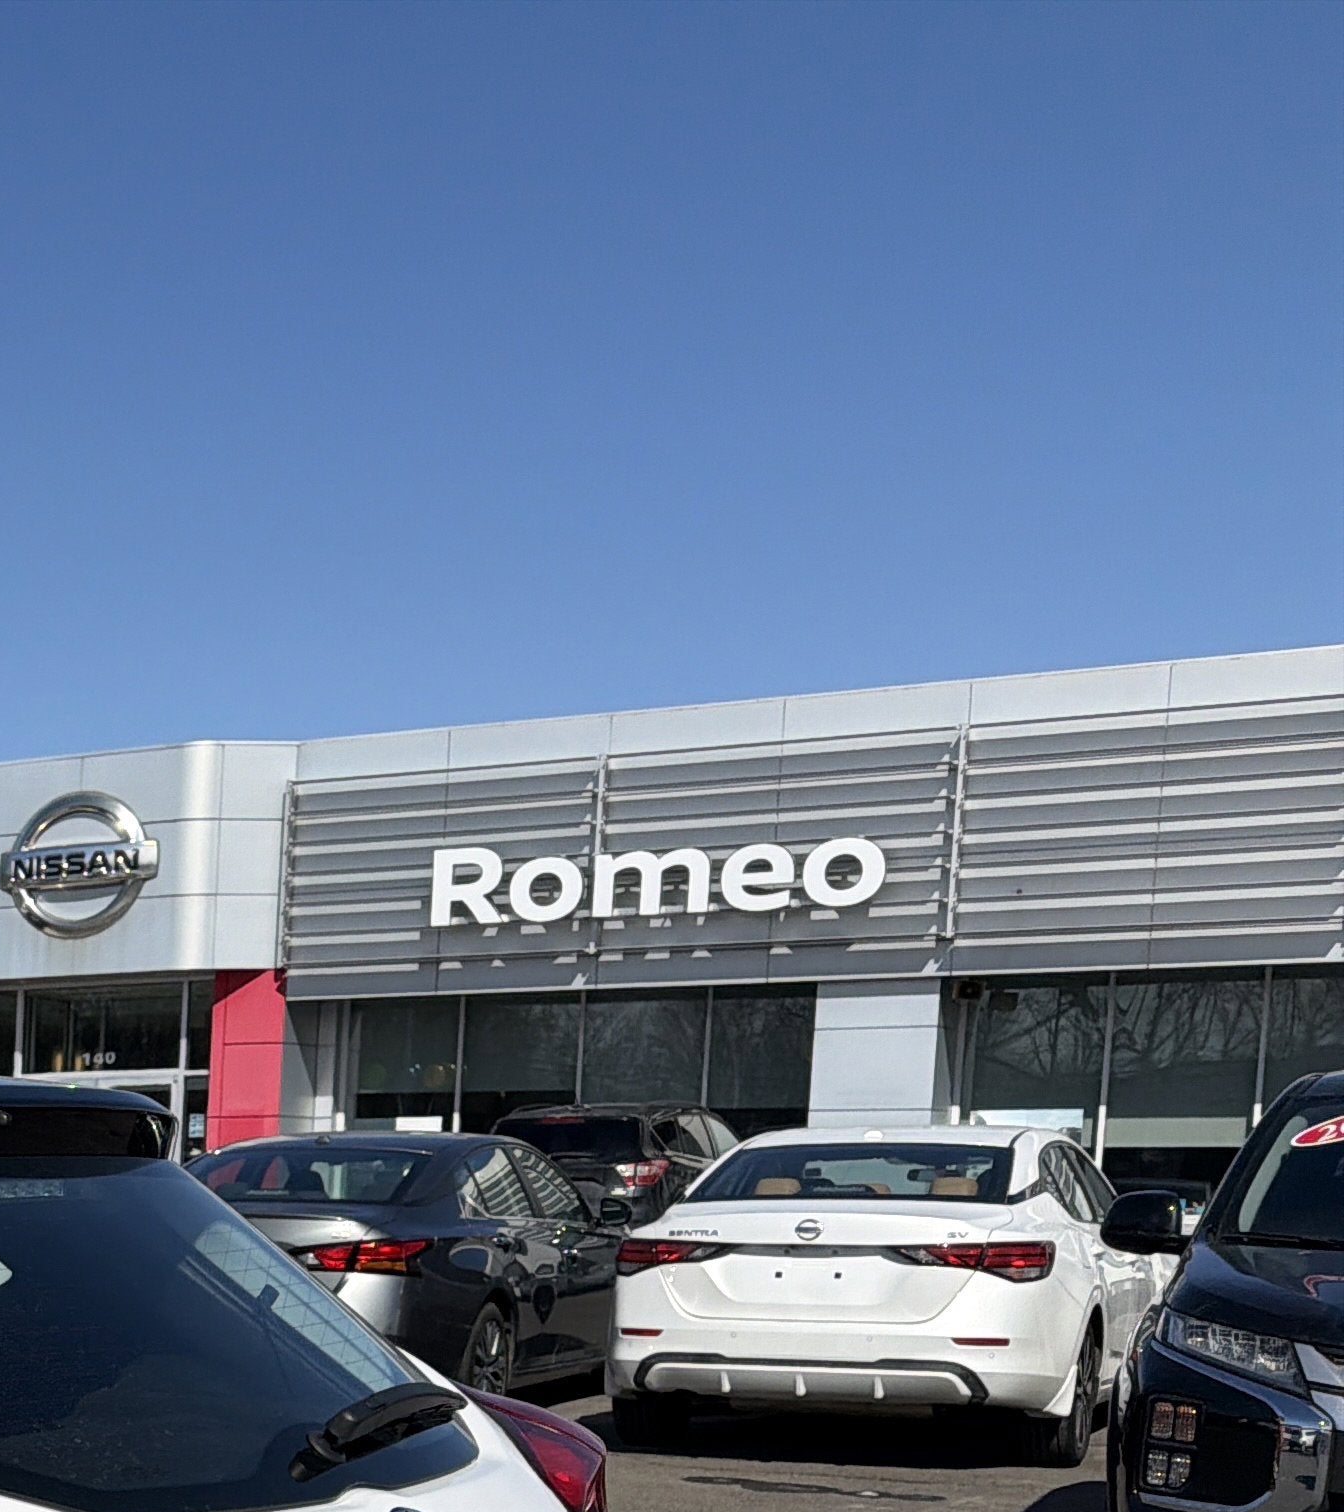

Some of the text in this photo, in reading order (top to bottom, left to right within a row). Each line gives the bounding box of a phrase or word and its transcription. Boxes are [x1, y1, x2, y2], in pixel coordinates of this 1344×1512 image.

[12, 849, 140, 881] NISSAN
[430, 836, 887, 927] Romeo
[81, 1051, 116, 1067] 140
